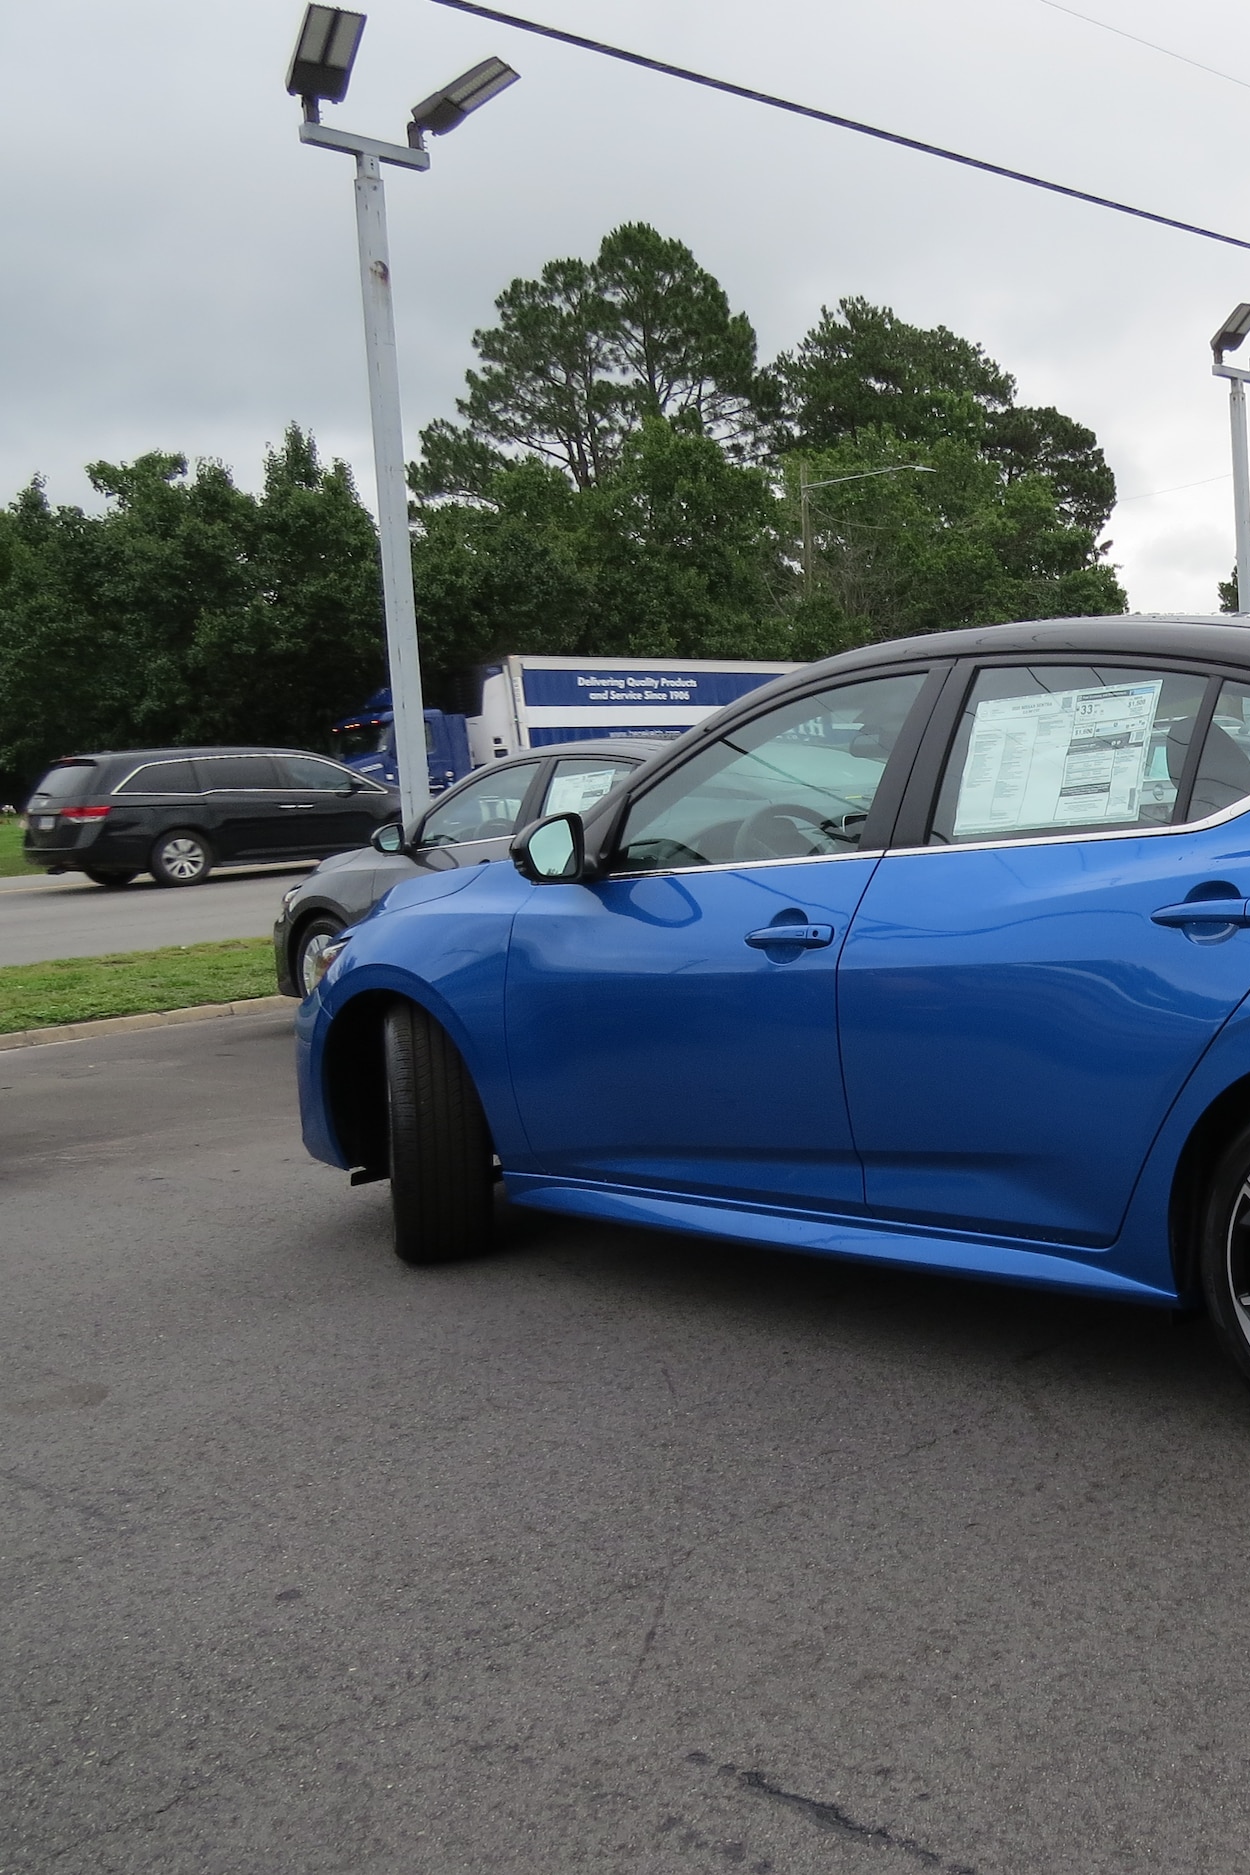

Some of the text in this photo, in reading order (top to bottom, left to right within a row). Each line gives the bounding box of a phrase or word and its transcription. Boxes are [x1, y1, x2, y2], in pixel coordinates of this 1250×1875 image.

[577, 676, 697, 689] Delivering Quality Products
[589, 690, 690, 700] and Service Since 1906
[1080, 704, 1093, 715] 33
